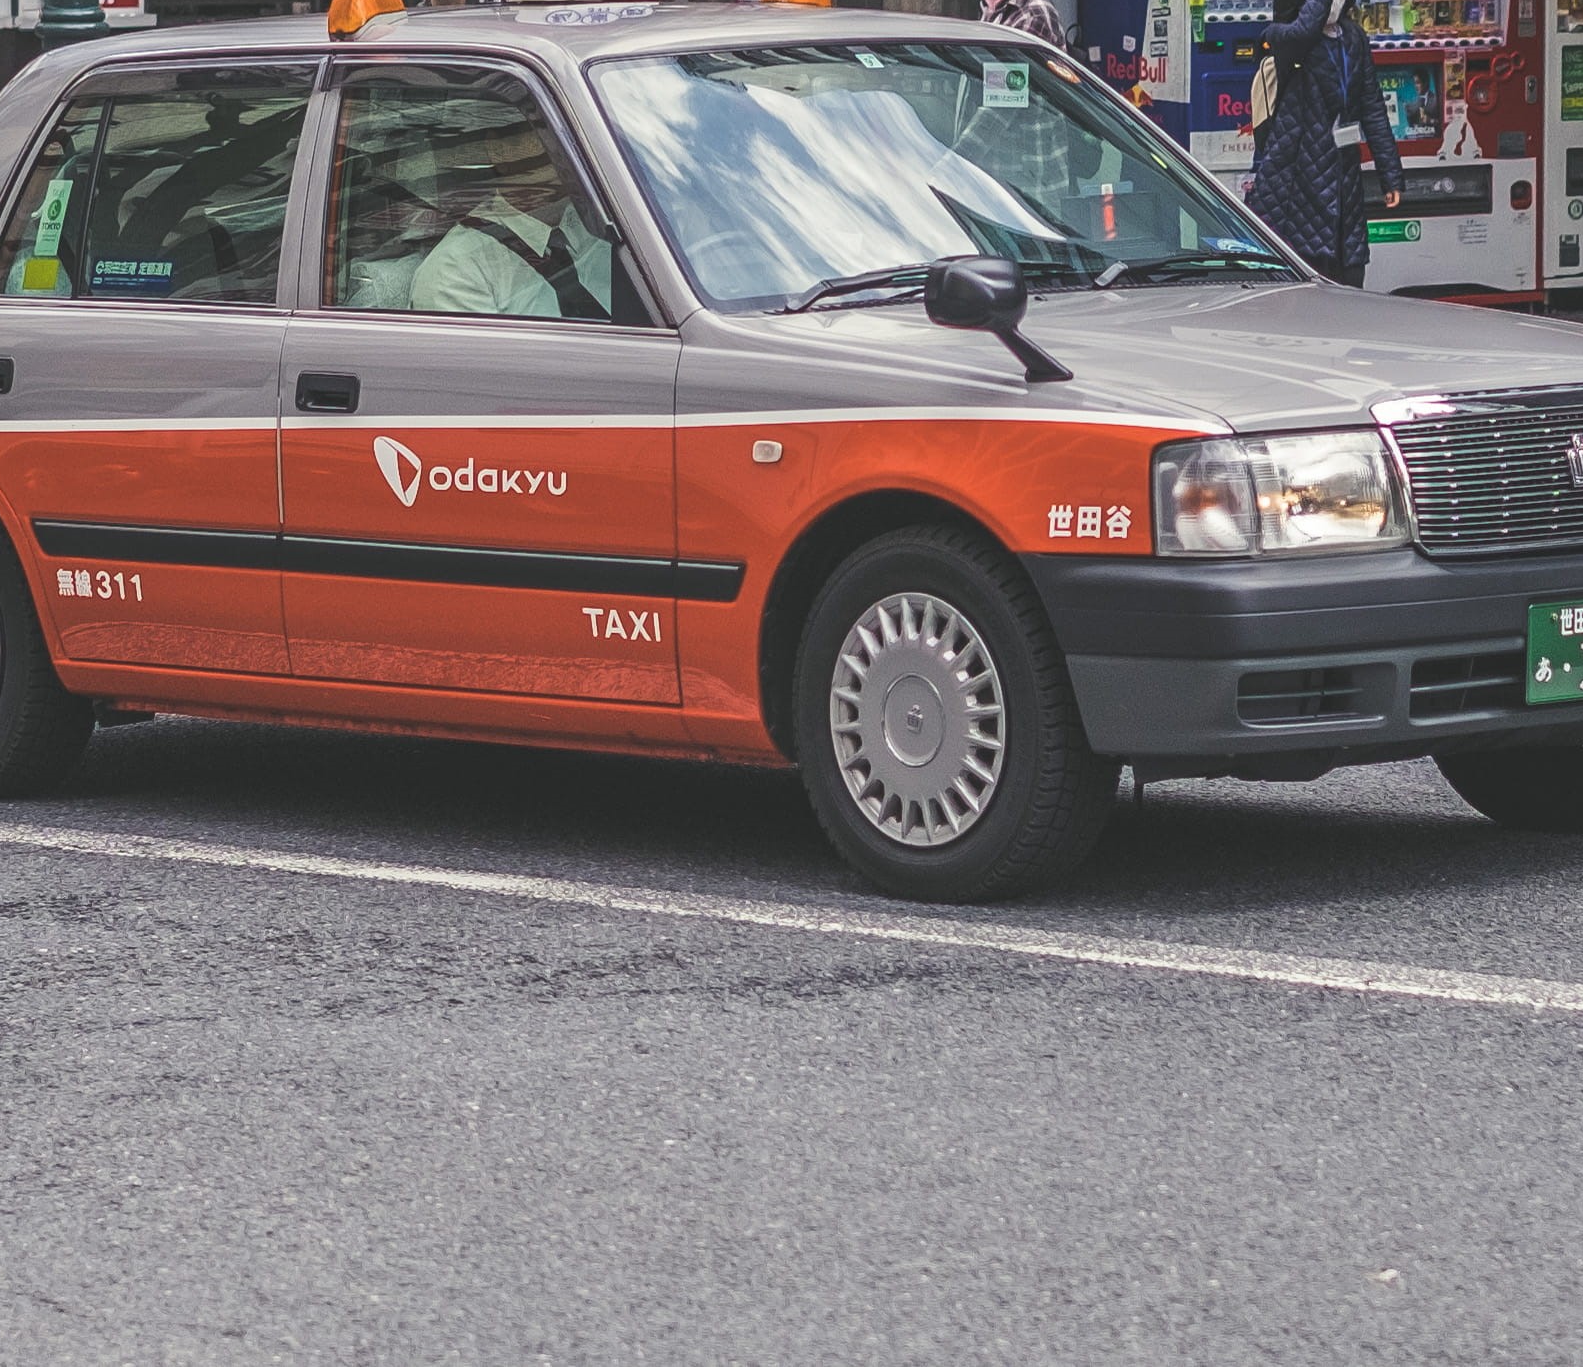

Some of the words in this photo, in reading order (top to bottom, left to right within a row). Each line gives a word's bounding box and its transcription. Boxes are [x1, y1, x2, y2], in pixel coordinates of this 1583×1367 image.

[1106, 52, 1138, 80] Red
[1139, 56, 1168, 84] Bull
[429, 457, 568, 496] odakyu
[1047, 504, 1131, 540] 世田谷
[56, 569, 144, 602] 無線311
[582, 606, 663, 643] TAXI
[1535, 656, 1553, 682] あ
